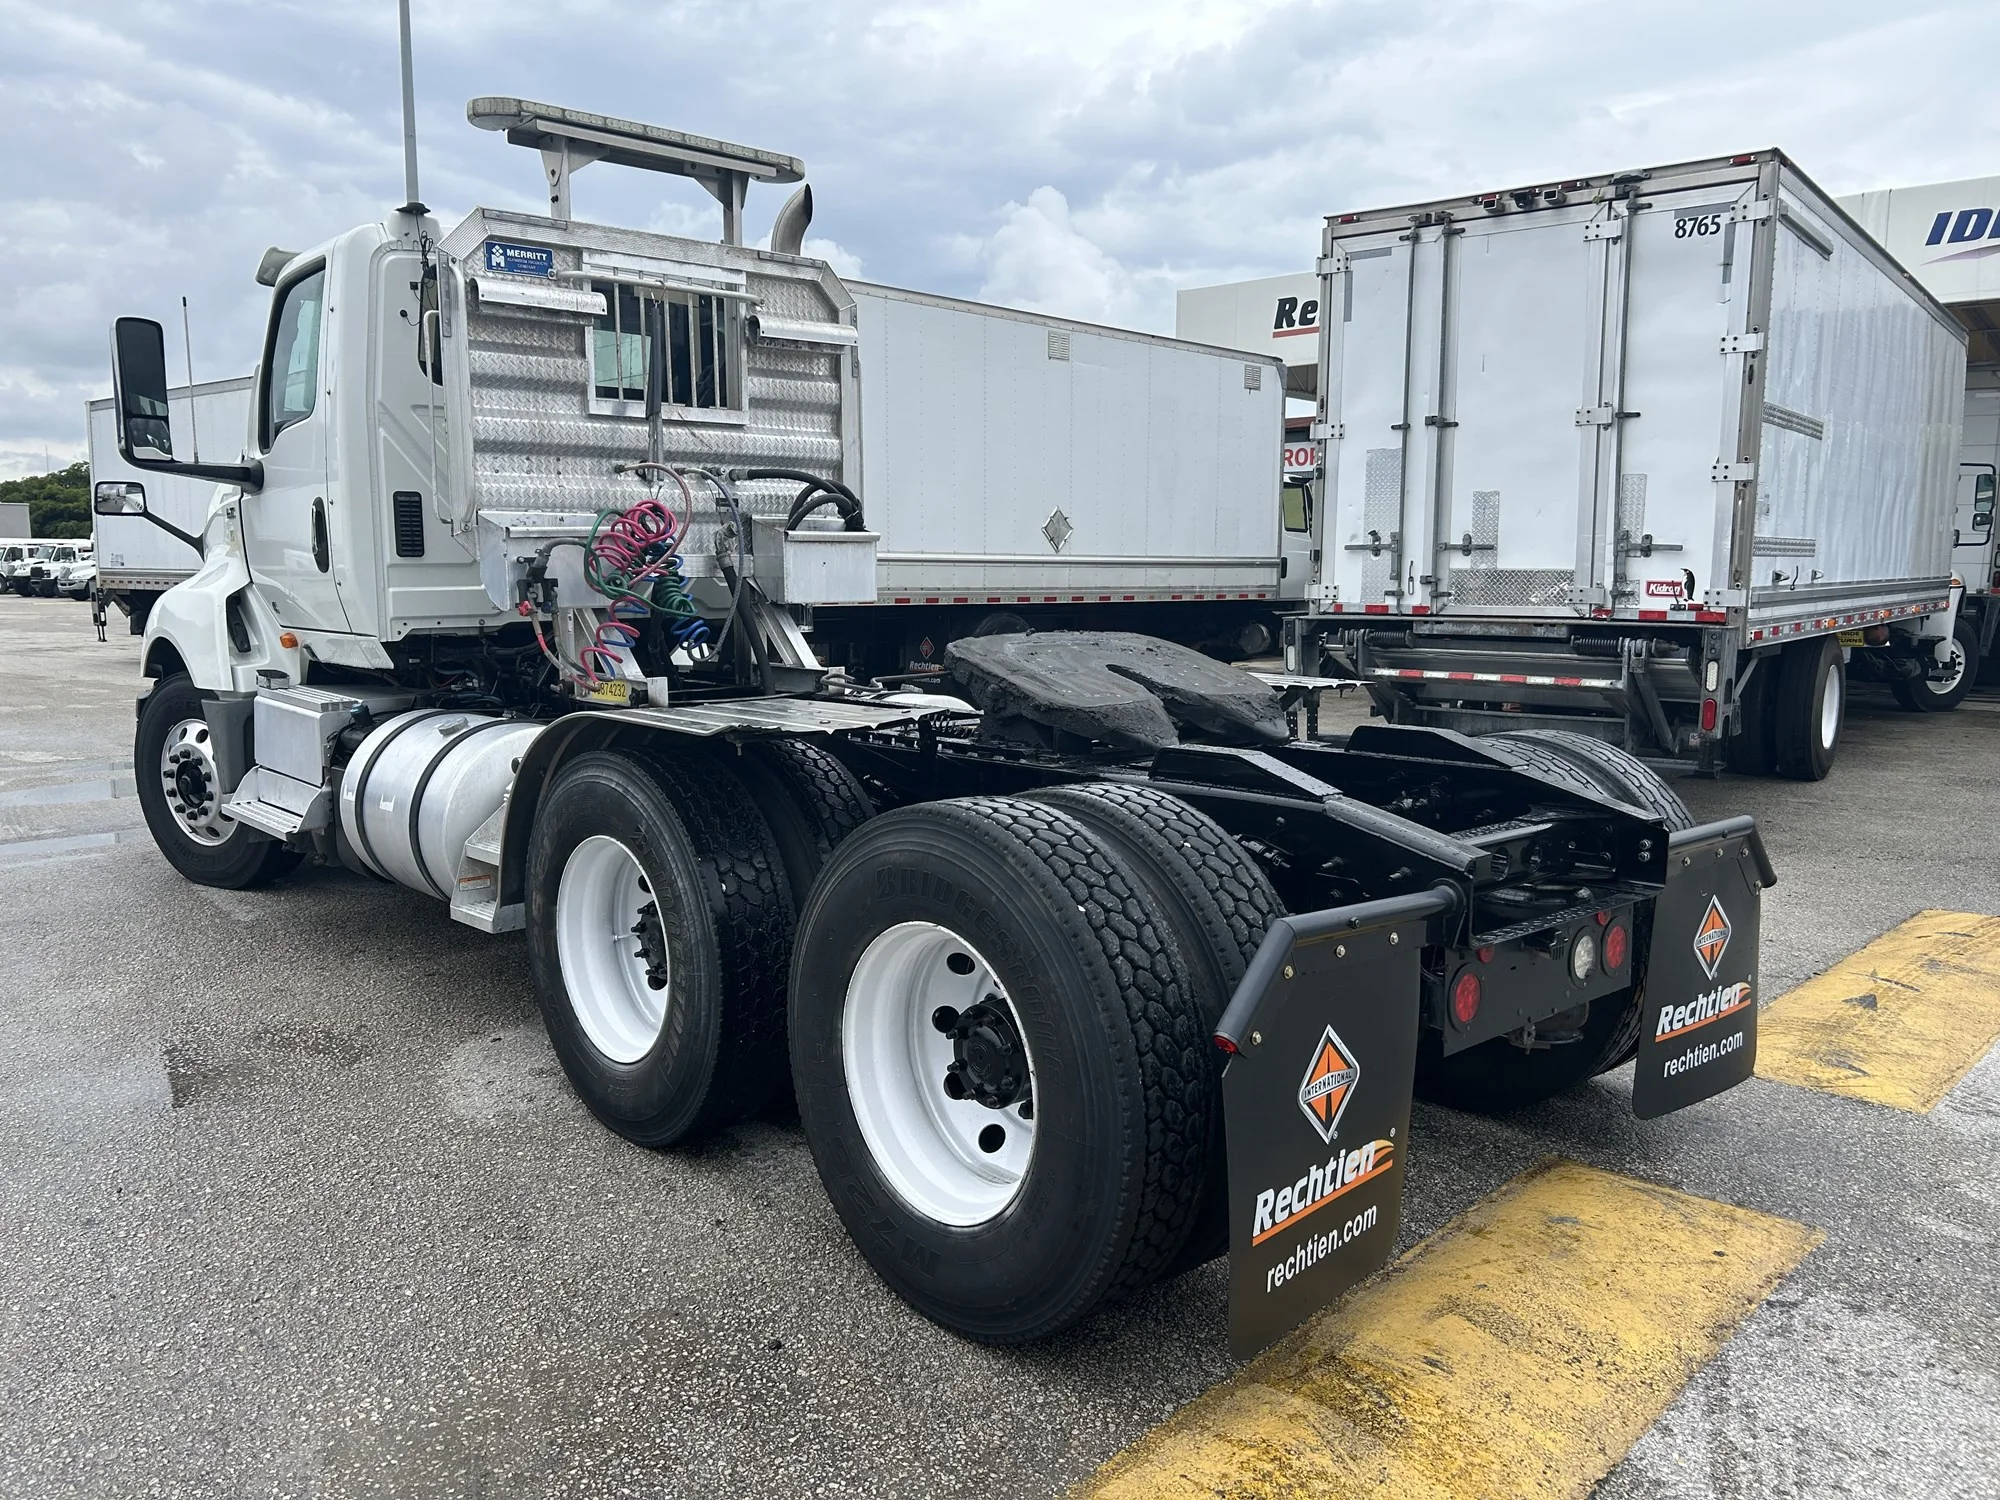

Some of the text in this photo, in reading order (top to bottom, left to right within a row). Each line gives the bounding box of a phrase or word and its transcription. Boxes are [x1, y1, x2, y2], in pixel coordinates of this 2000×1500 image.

[1674, 213, 1722, 239] 8765
[506, 248, 548, 262] MERRITT
[1648, 583, 1681, 595] Kidron
[909, 660, 939, 671] Rechtien
[1697, 927, 1729, 944] INTERNATIONAL
[1655, 981, 1741, 1037] Rechtien
[1663, 1030, 1744, 1078] rechtien.com
[1303, 1068, 1353, 1099] INTERNATIONAL
[1252, 1139, 1377, 1238] Rechtien
[1266, 1204, 1378, 1293] rechtien.com
